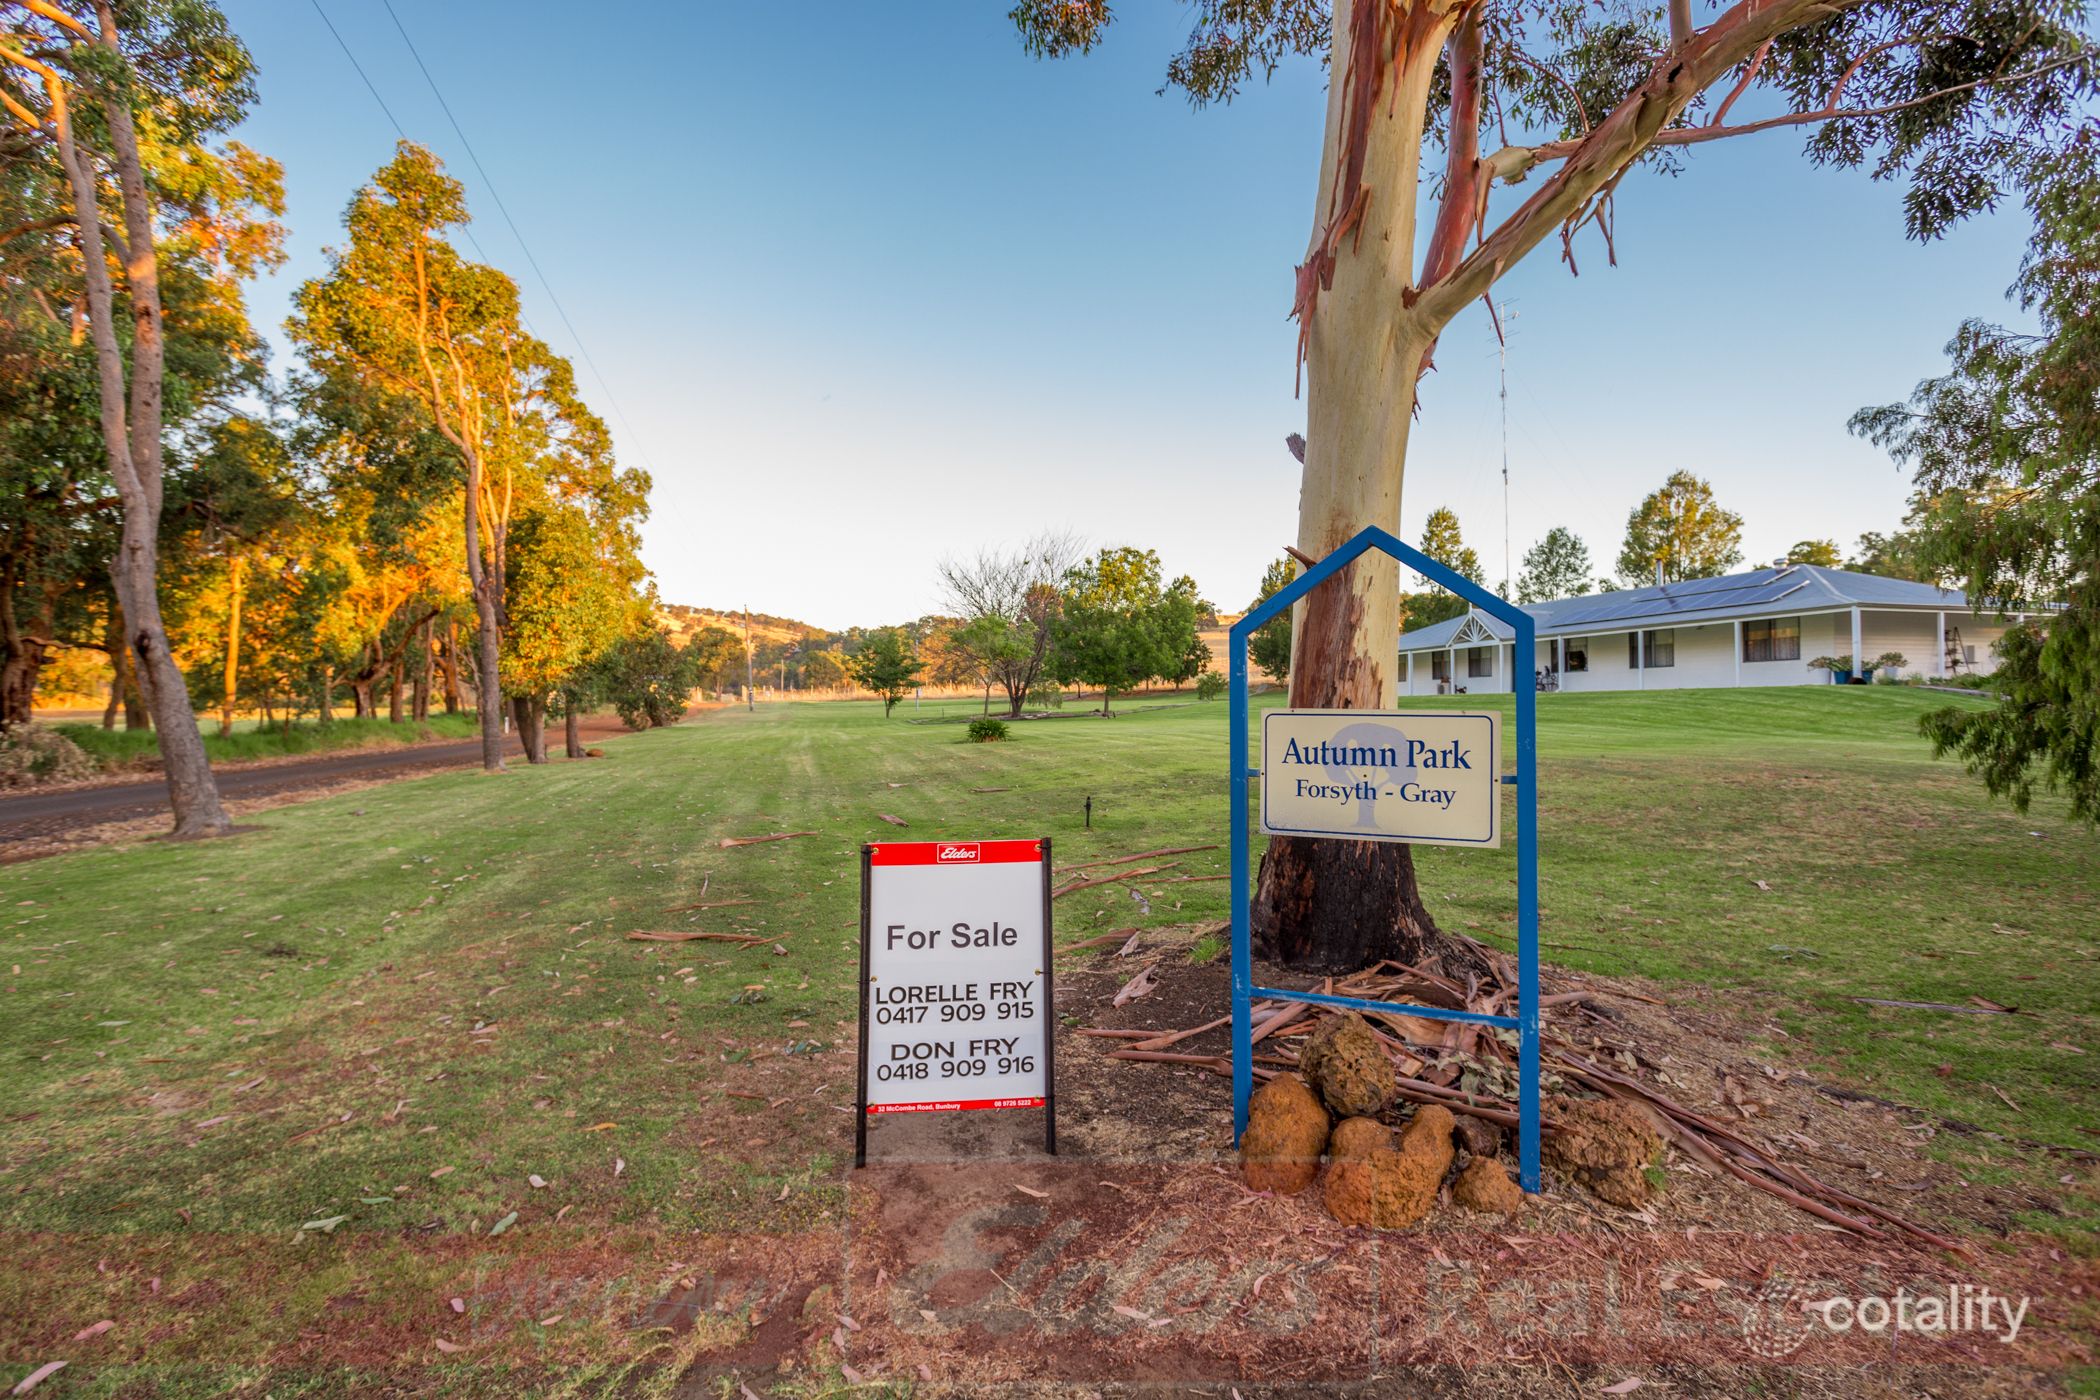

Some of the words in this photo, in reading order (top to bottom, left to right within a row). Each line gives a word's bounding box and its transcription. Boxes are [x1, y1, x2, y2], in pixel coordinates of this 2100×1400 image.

[1281, 737, 1398, 768] Autumn
[1405, 739, 1472, 770] Park
[1295, 778, 1378, 806] Forsyth
[1399, 782, 1457, 810] Gray
[940, 847, 977, 859] Elders
[887, 925, 941, 951] For
[950, 922, 1018, 949] Sale
[875, 983, 978, 1005] LORELLE
[989, 981, 1034, 1000] FRY
[876, 1006, 929, 1025] 0417
[940, 1003, 986, 1022] 909
[997, 1001, 1034, 1020] 915
[890, 1041, 955, 1061] DON
[969, 1037, 1020, 1057] FRY
[876, 1062, 929, 1081] 0418
[940, 1059, 986, 1079] 909
[997, 1056, 1035, 1075] 916
